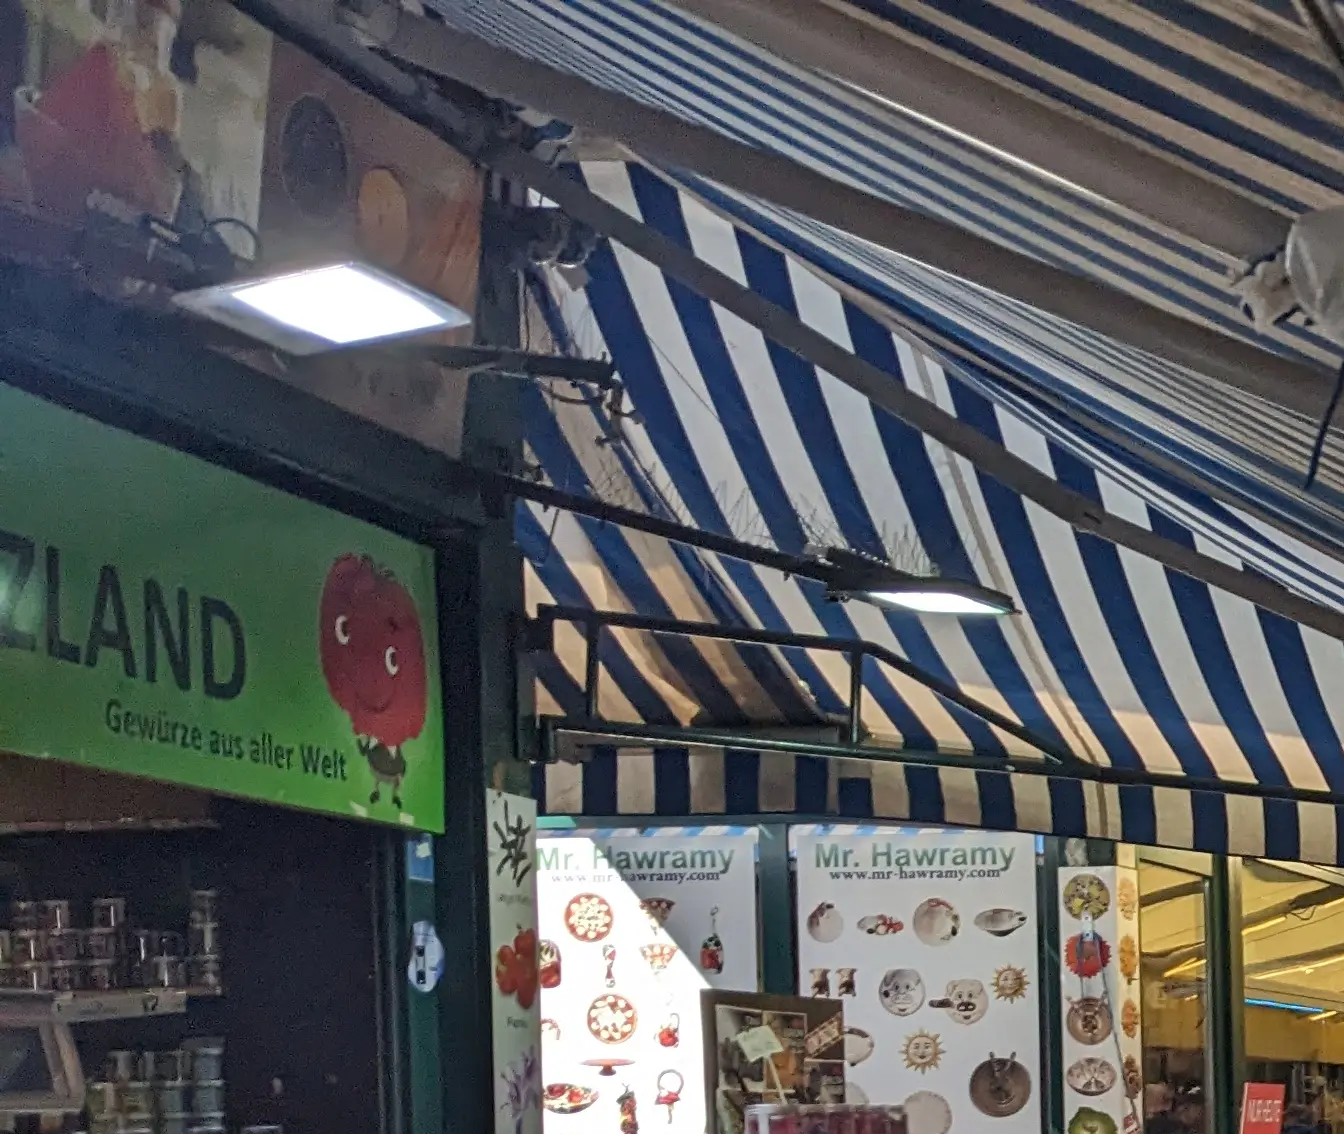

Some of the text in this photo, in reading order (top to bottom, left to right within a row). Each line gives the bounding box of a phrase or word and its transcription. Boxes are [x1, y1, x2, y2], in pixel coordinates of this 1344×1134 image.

[104, 699, 348, 782] Gewürze aus aller Welt
[593, 845, 735, 875] Hawramy
[815, 842, 1016, 872] Mr. Hawramy
[829, 866, 1000, 882] www.mr-hawramy.com
